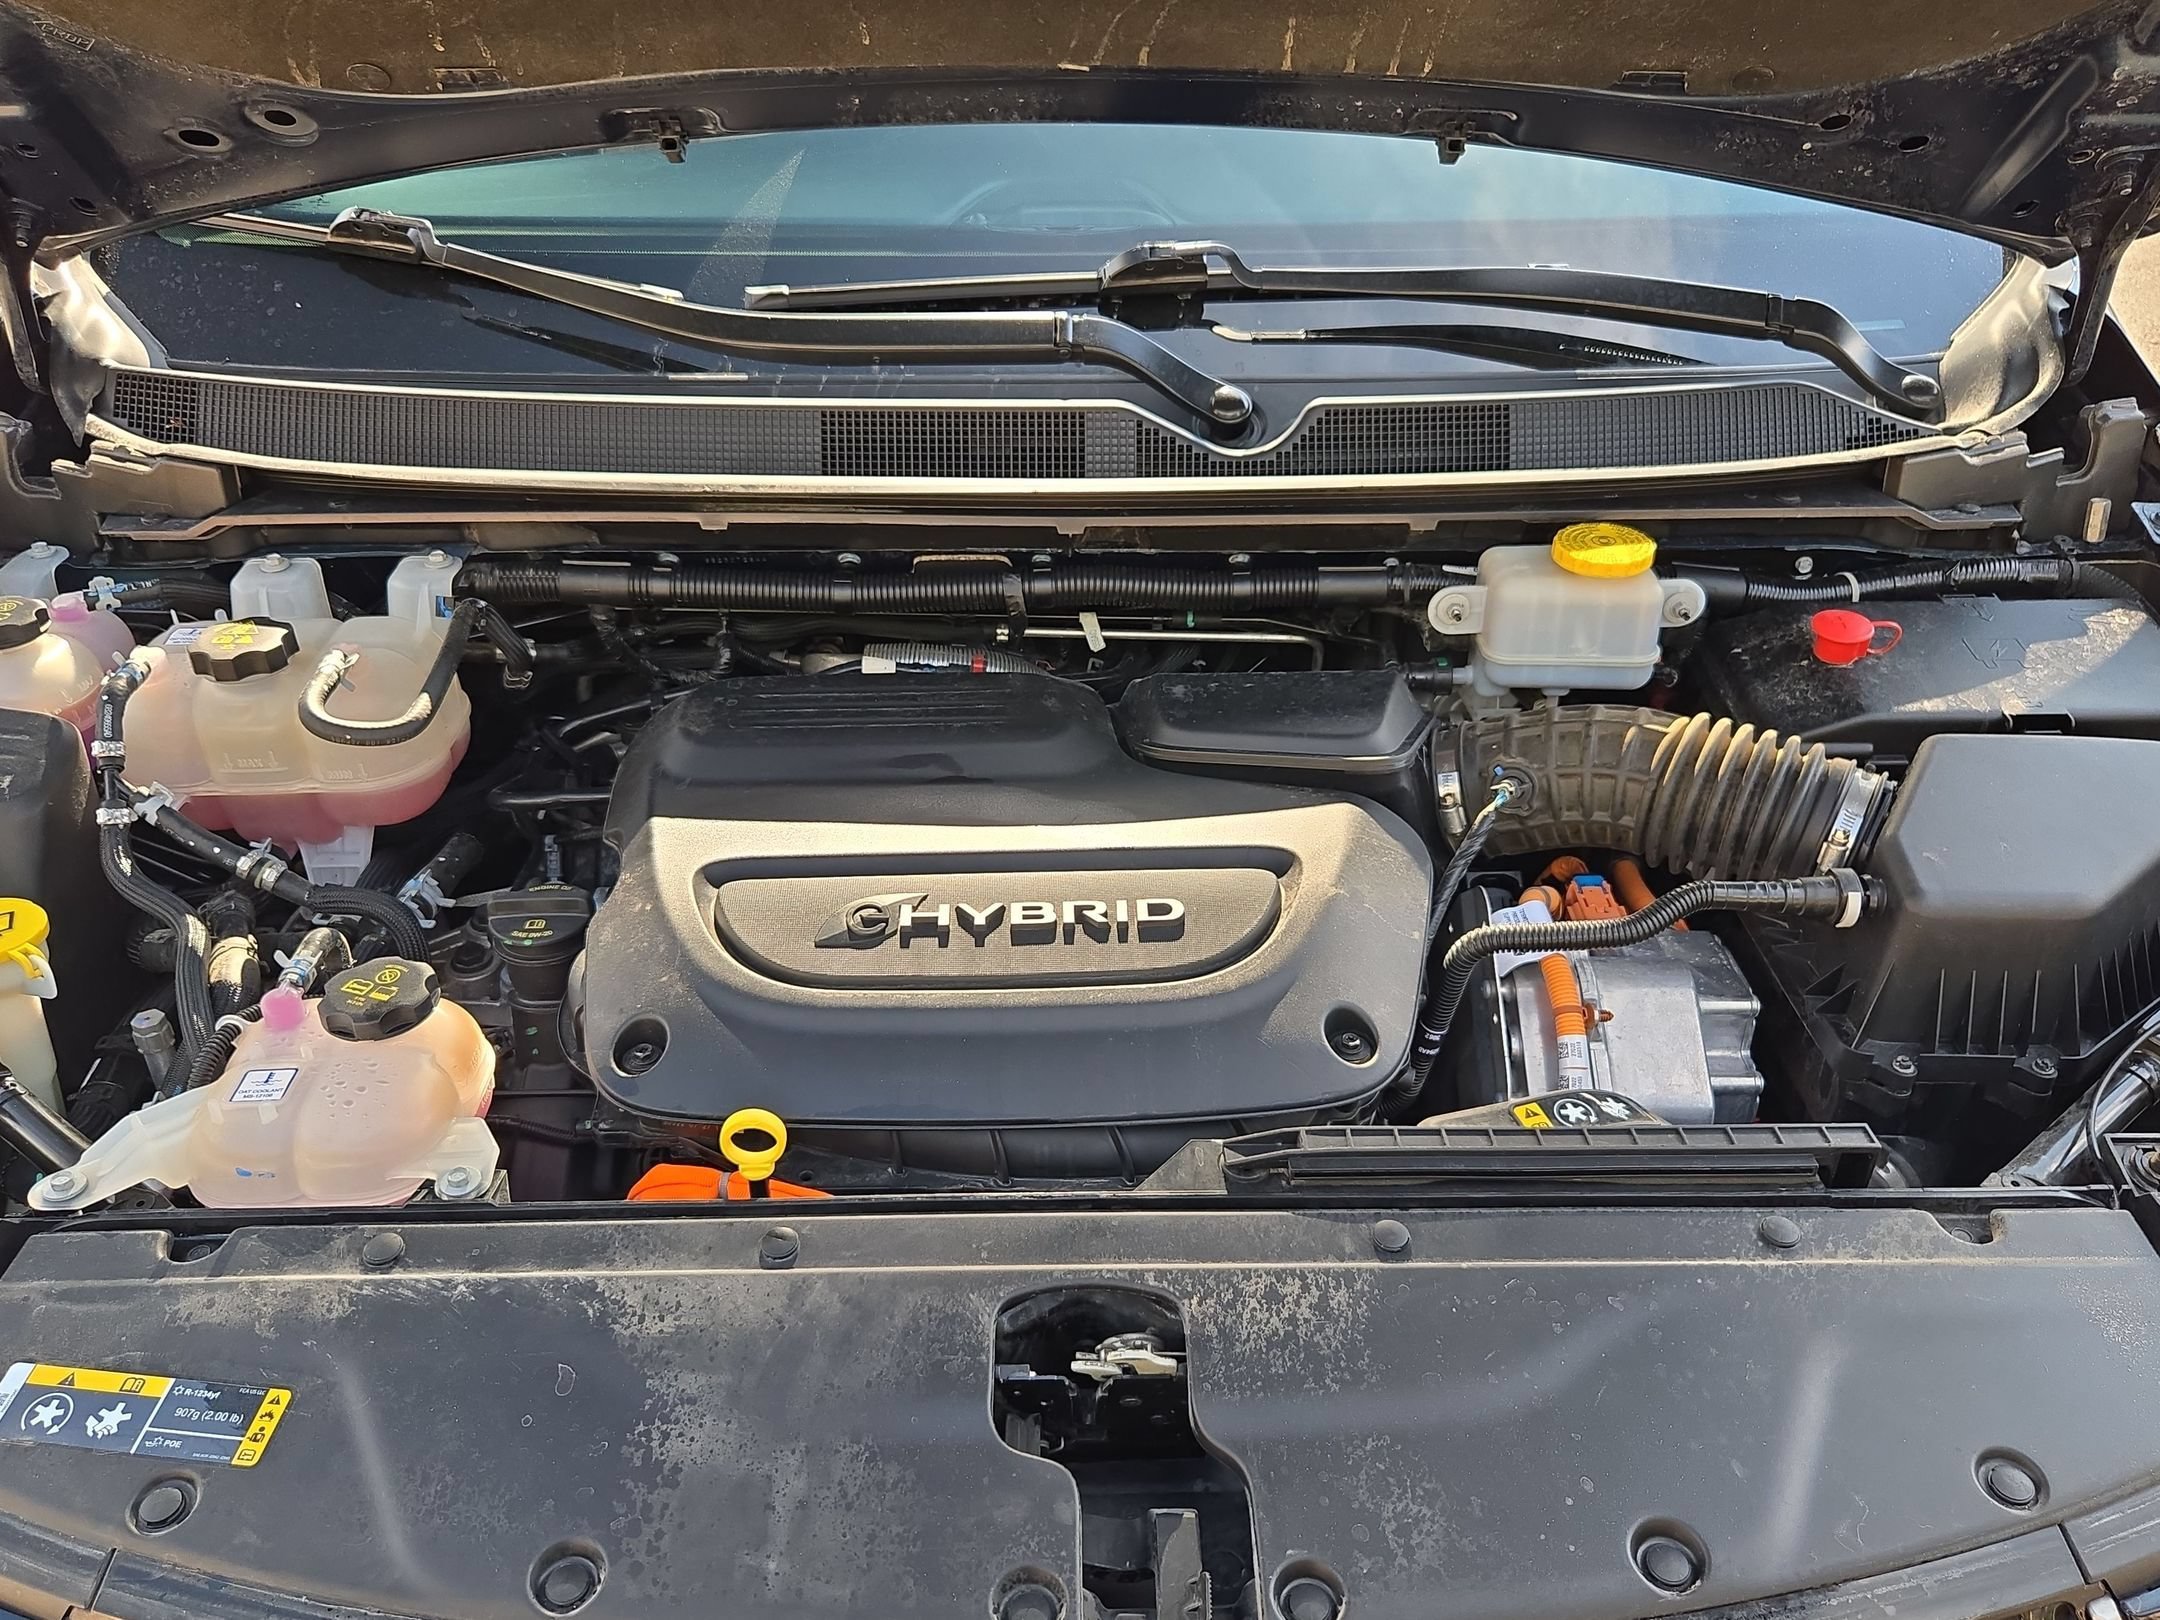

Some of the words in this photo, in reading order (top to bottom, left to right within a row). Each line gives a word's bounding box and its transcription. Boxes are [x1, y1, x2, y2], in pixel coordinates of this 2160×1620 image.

[184, 1388, 221, 1400] R-1234yf
[174, 1407, 201, 1421] 907g
[201, 1410, 228, 1422] (2.00
[229, 1413, 244, 1424] lb)
[163, 1440, 183, 1448] POE
